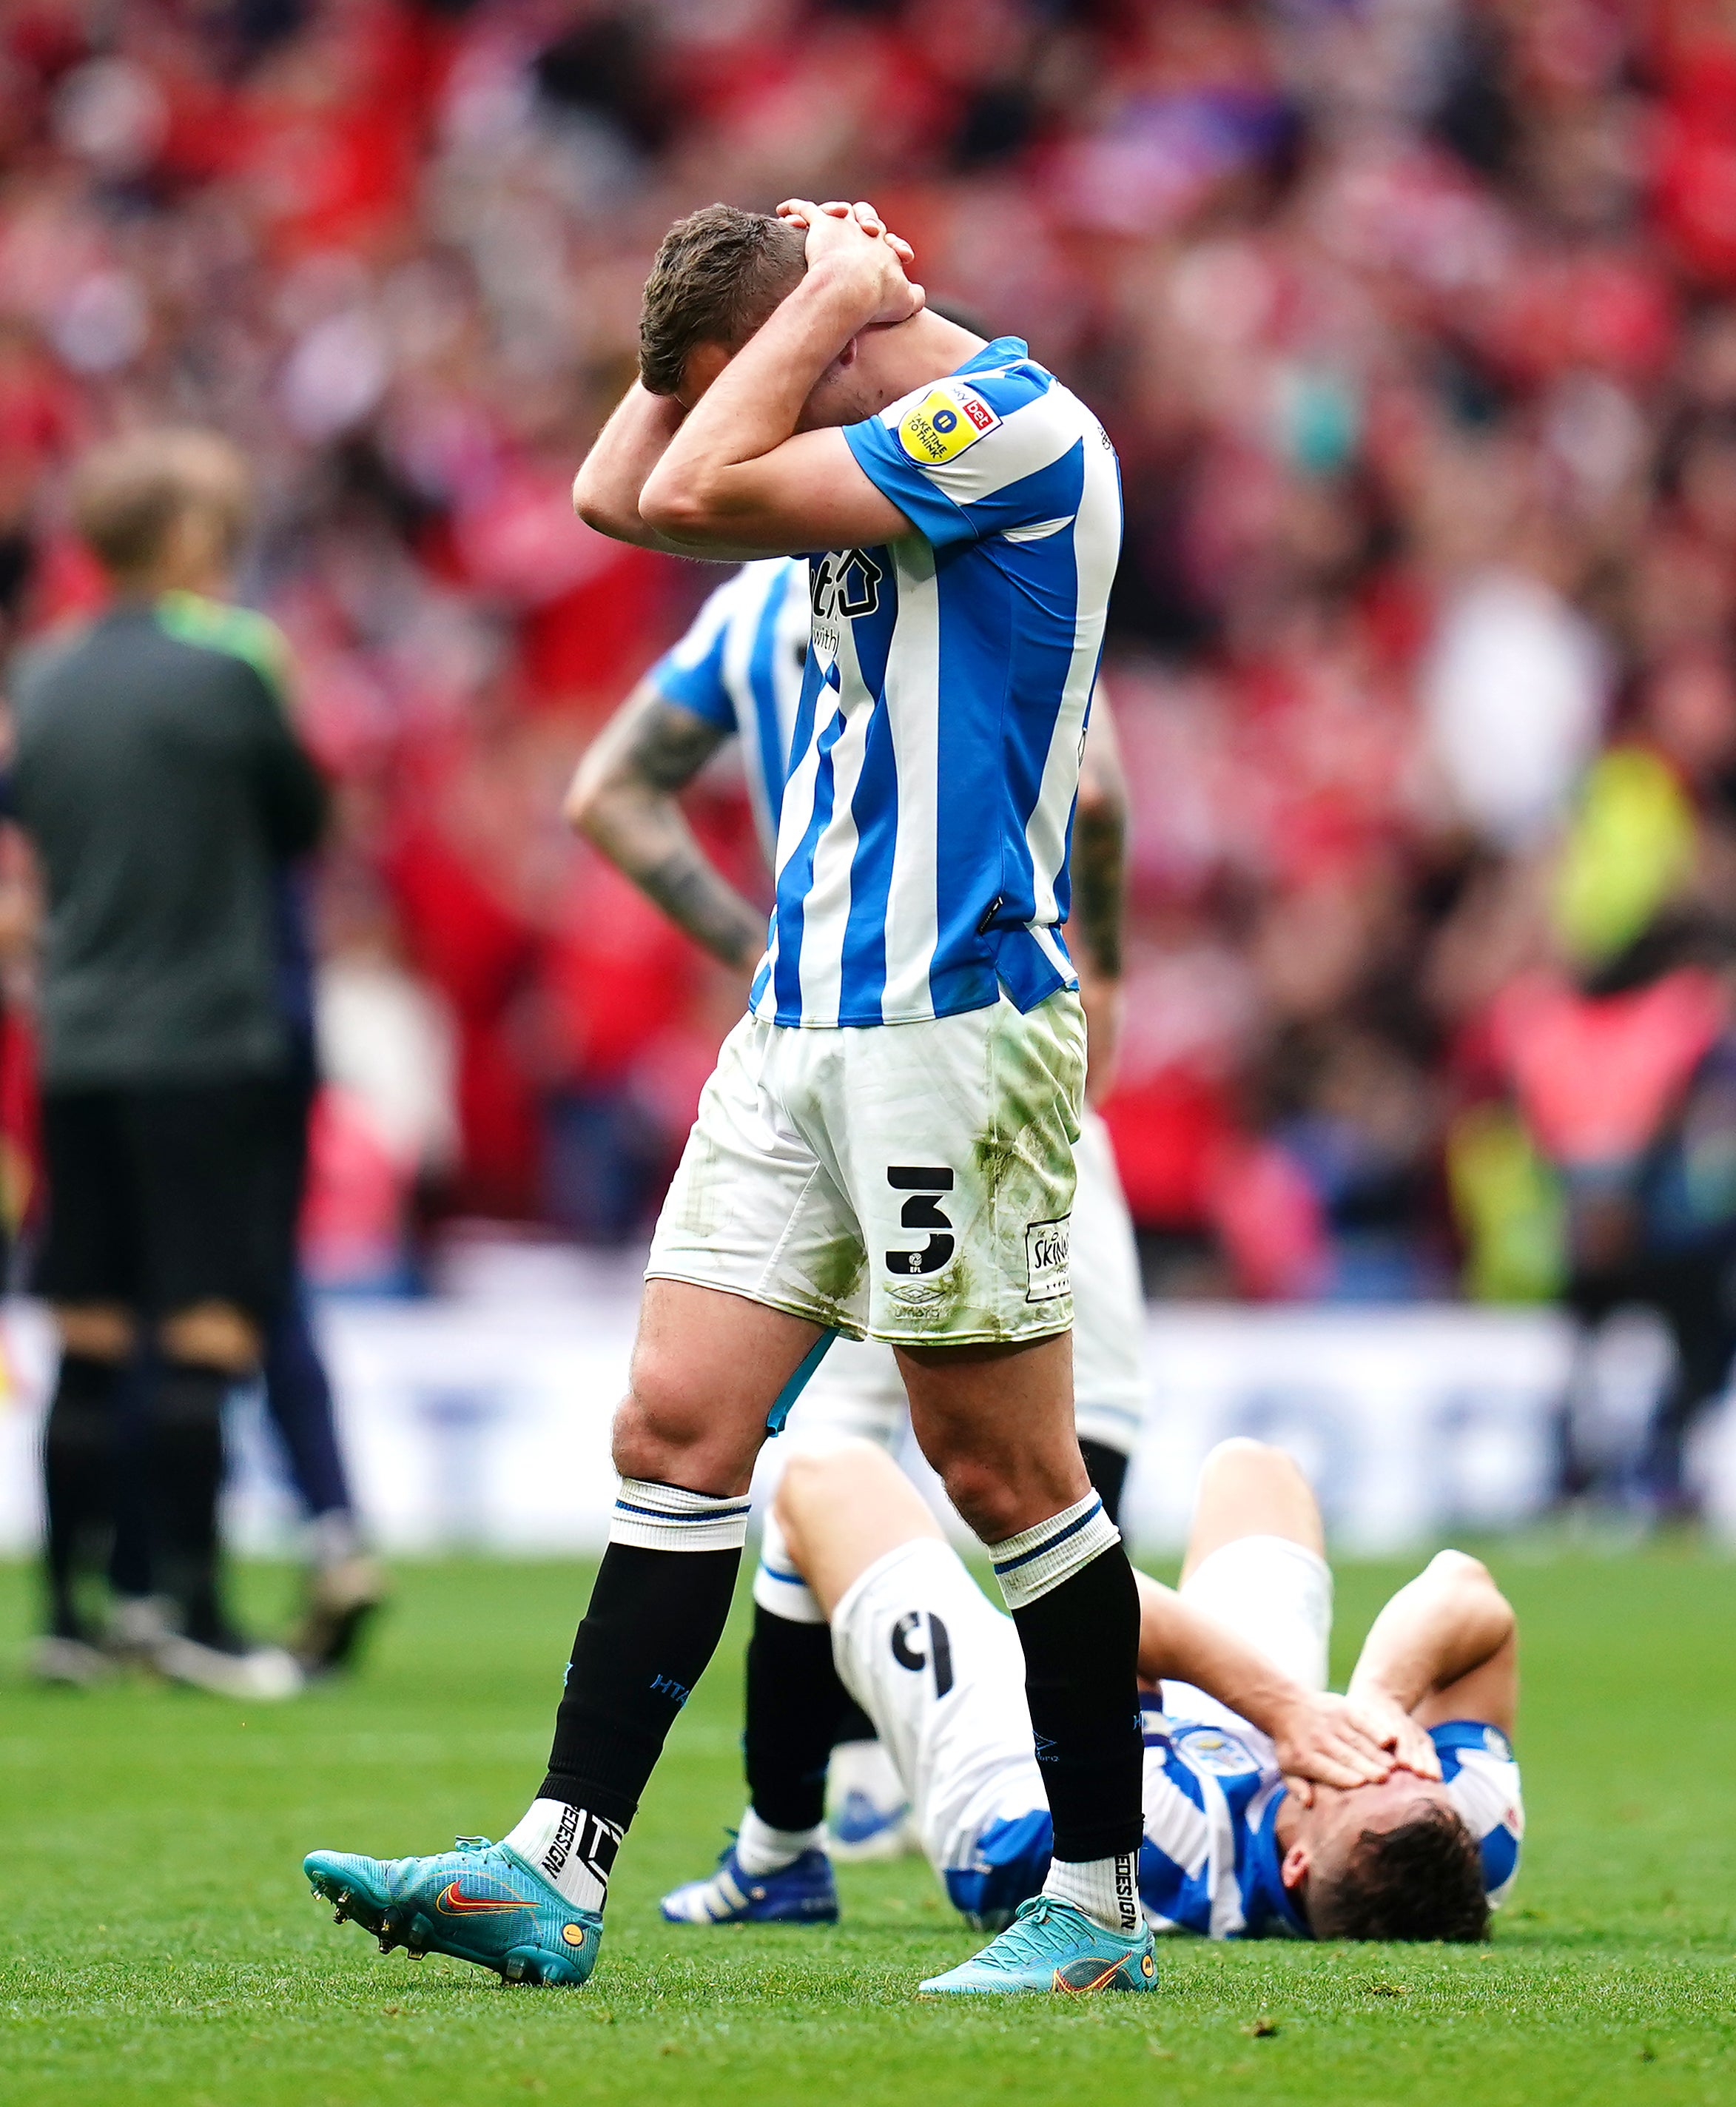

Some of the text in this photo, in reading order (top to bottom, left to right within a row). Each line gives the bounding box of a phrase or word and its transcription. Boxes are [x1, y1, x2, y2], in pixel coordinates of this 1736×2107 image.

[914, 413, 948, 454] TAKE TIME
[966, 402, 990, 428] bet
[908, 419, 940, 460] TO THINK
[814, 626, 837, 652] with
[885, 1166, 955, 1274] 3
[1114, 1854, 1137, 1931] EDESIGN
